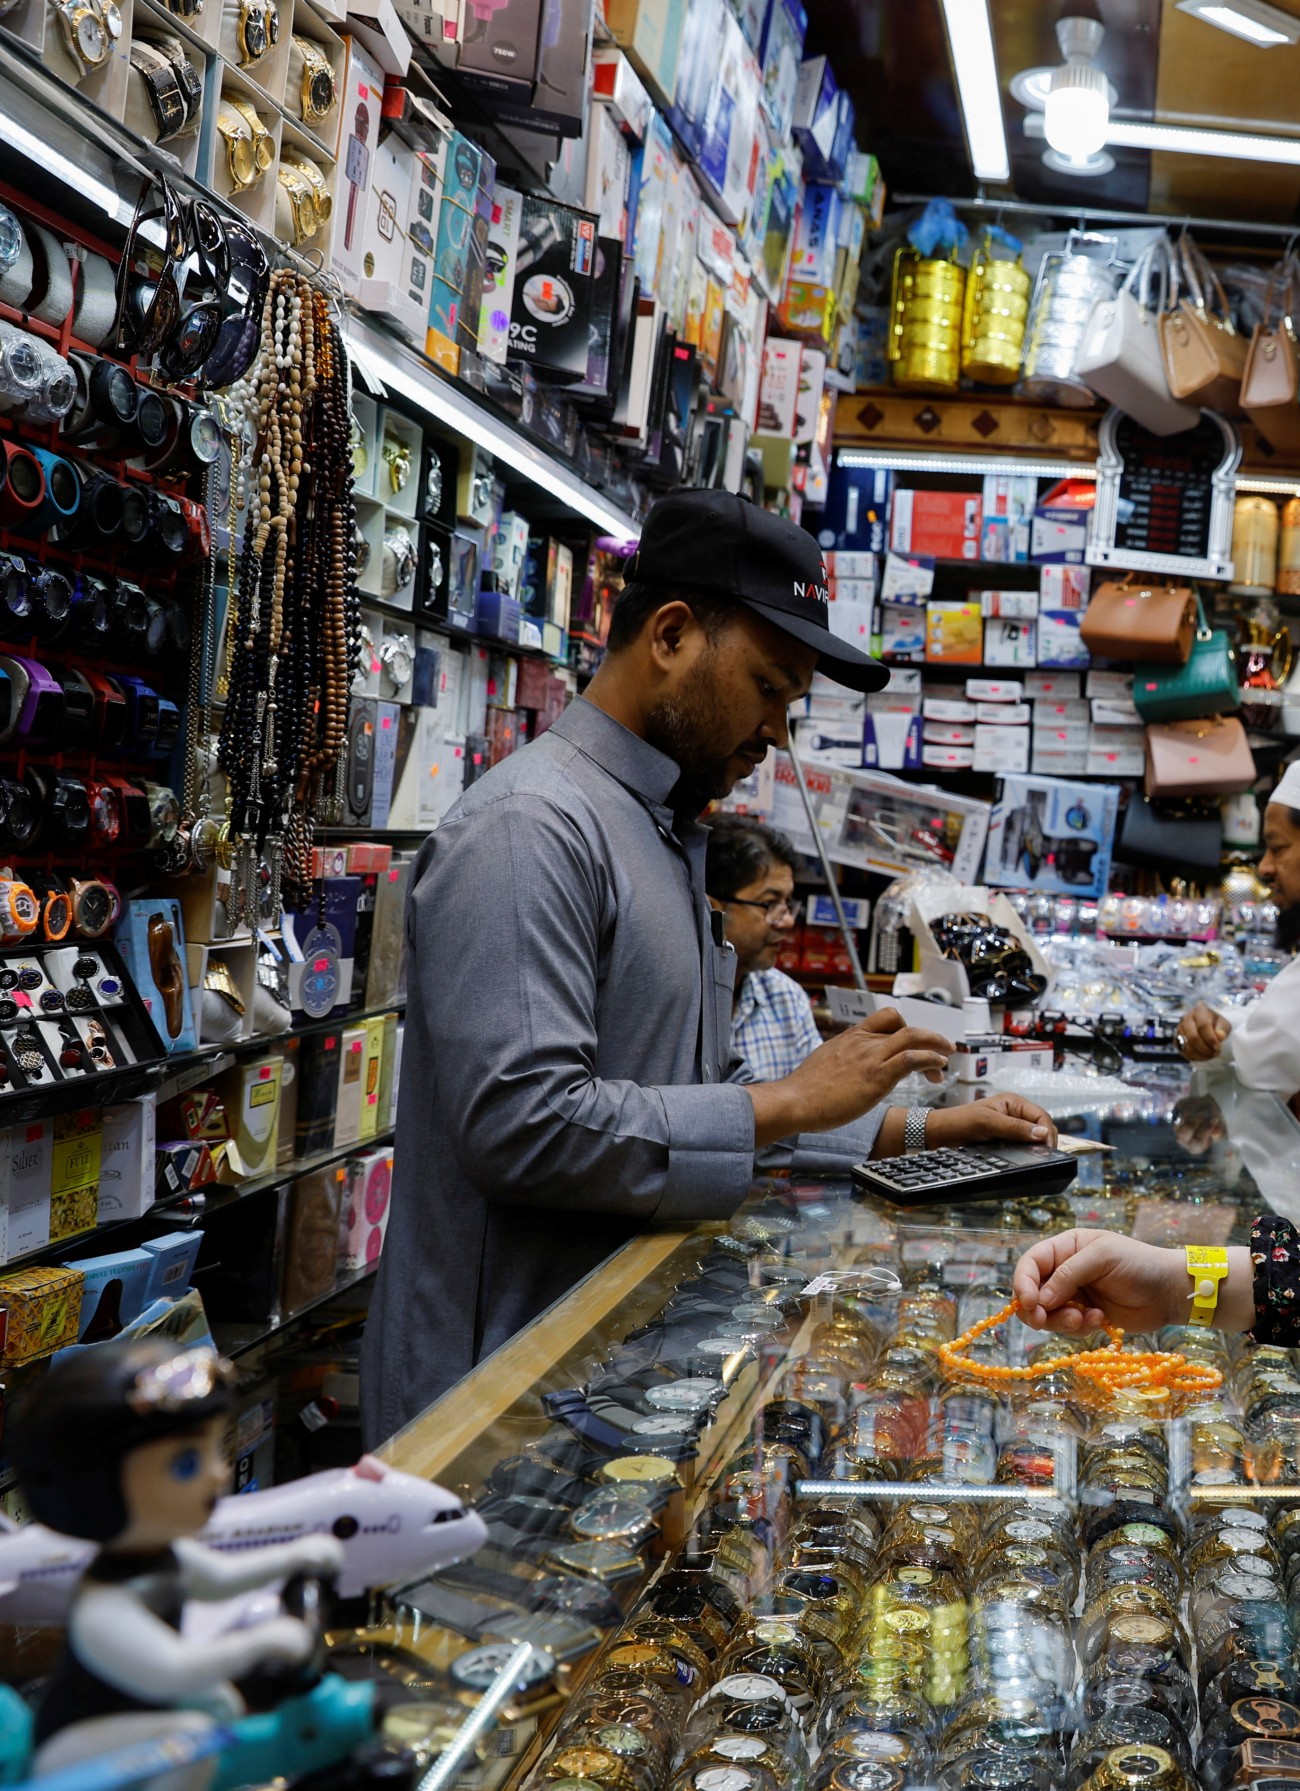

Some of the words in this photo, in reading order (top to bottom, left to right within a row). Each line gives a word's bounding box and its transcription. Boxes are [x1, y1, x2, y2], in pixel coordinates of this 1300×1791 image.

[492, 46, 517, 59] 750W
[503, 199, 514, 238] SMART
[809, 191, 826, 249] ANAS
[69, 1153, 90, 1169] FULL
